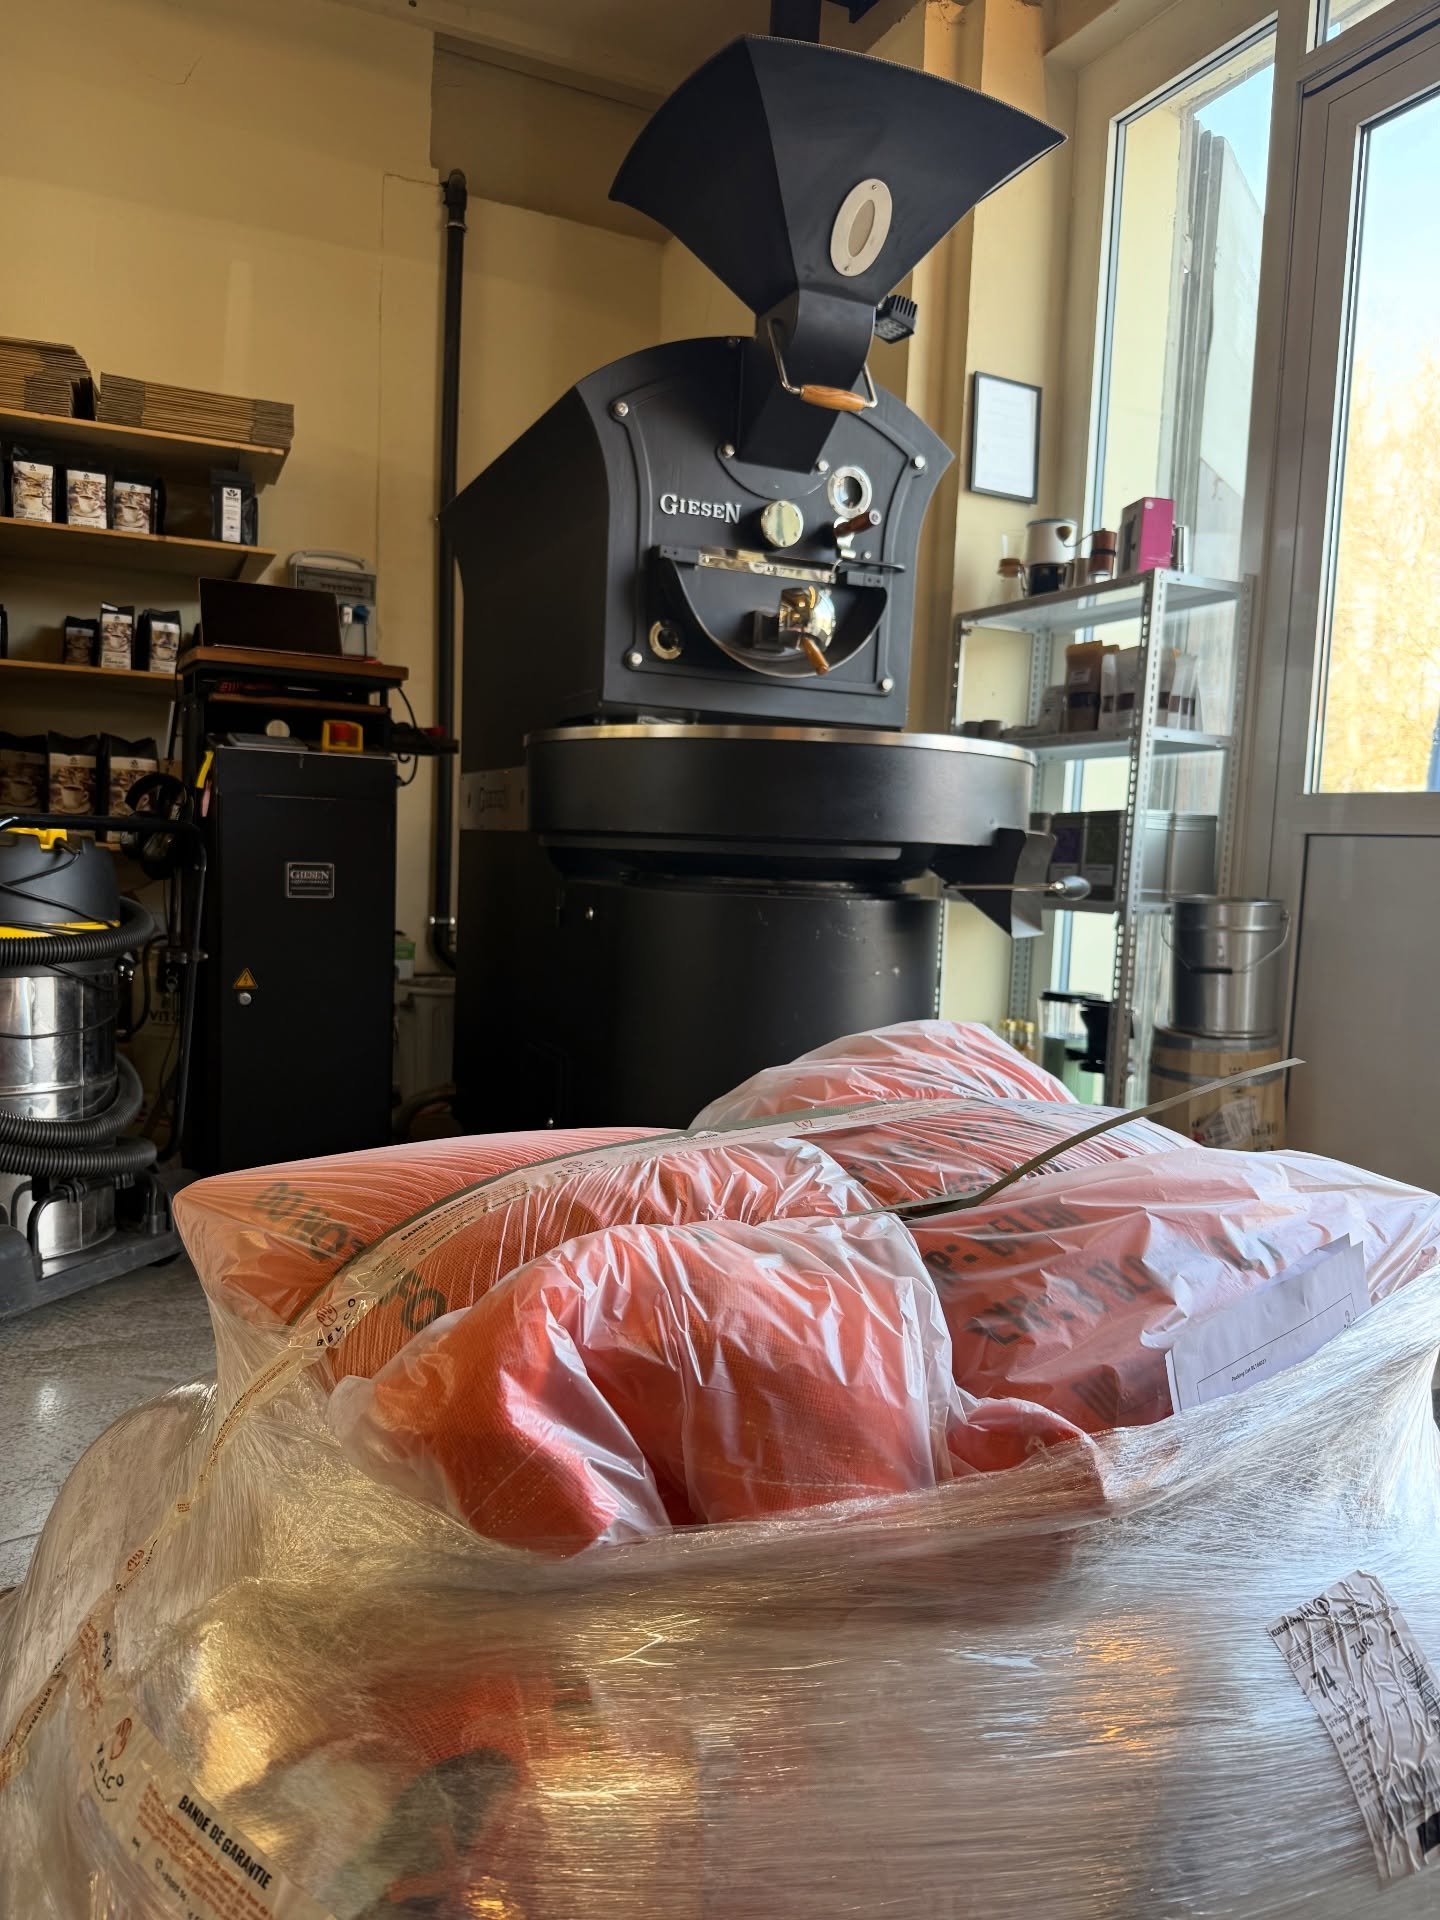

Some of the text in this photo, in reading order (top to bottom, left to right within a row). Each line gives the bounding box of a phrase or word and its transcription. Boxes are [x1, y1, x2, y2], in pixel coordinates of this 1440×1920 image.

[660, 493, 742, 524] GIESEN
[178, 1795, 273, 1890] BANDE DE GARANTIE
